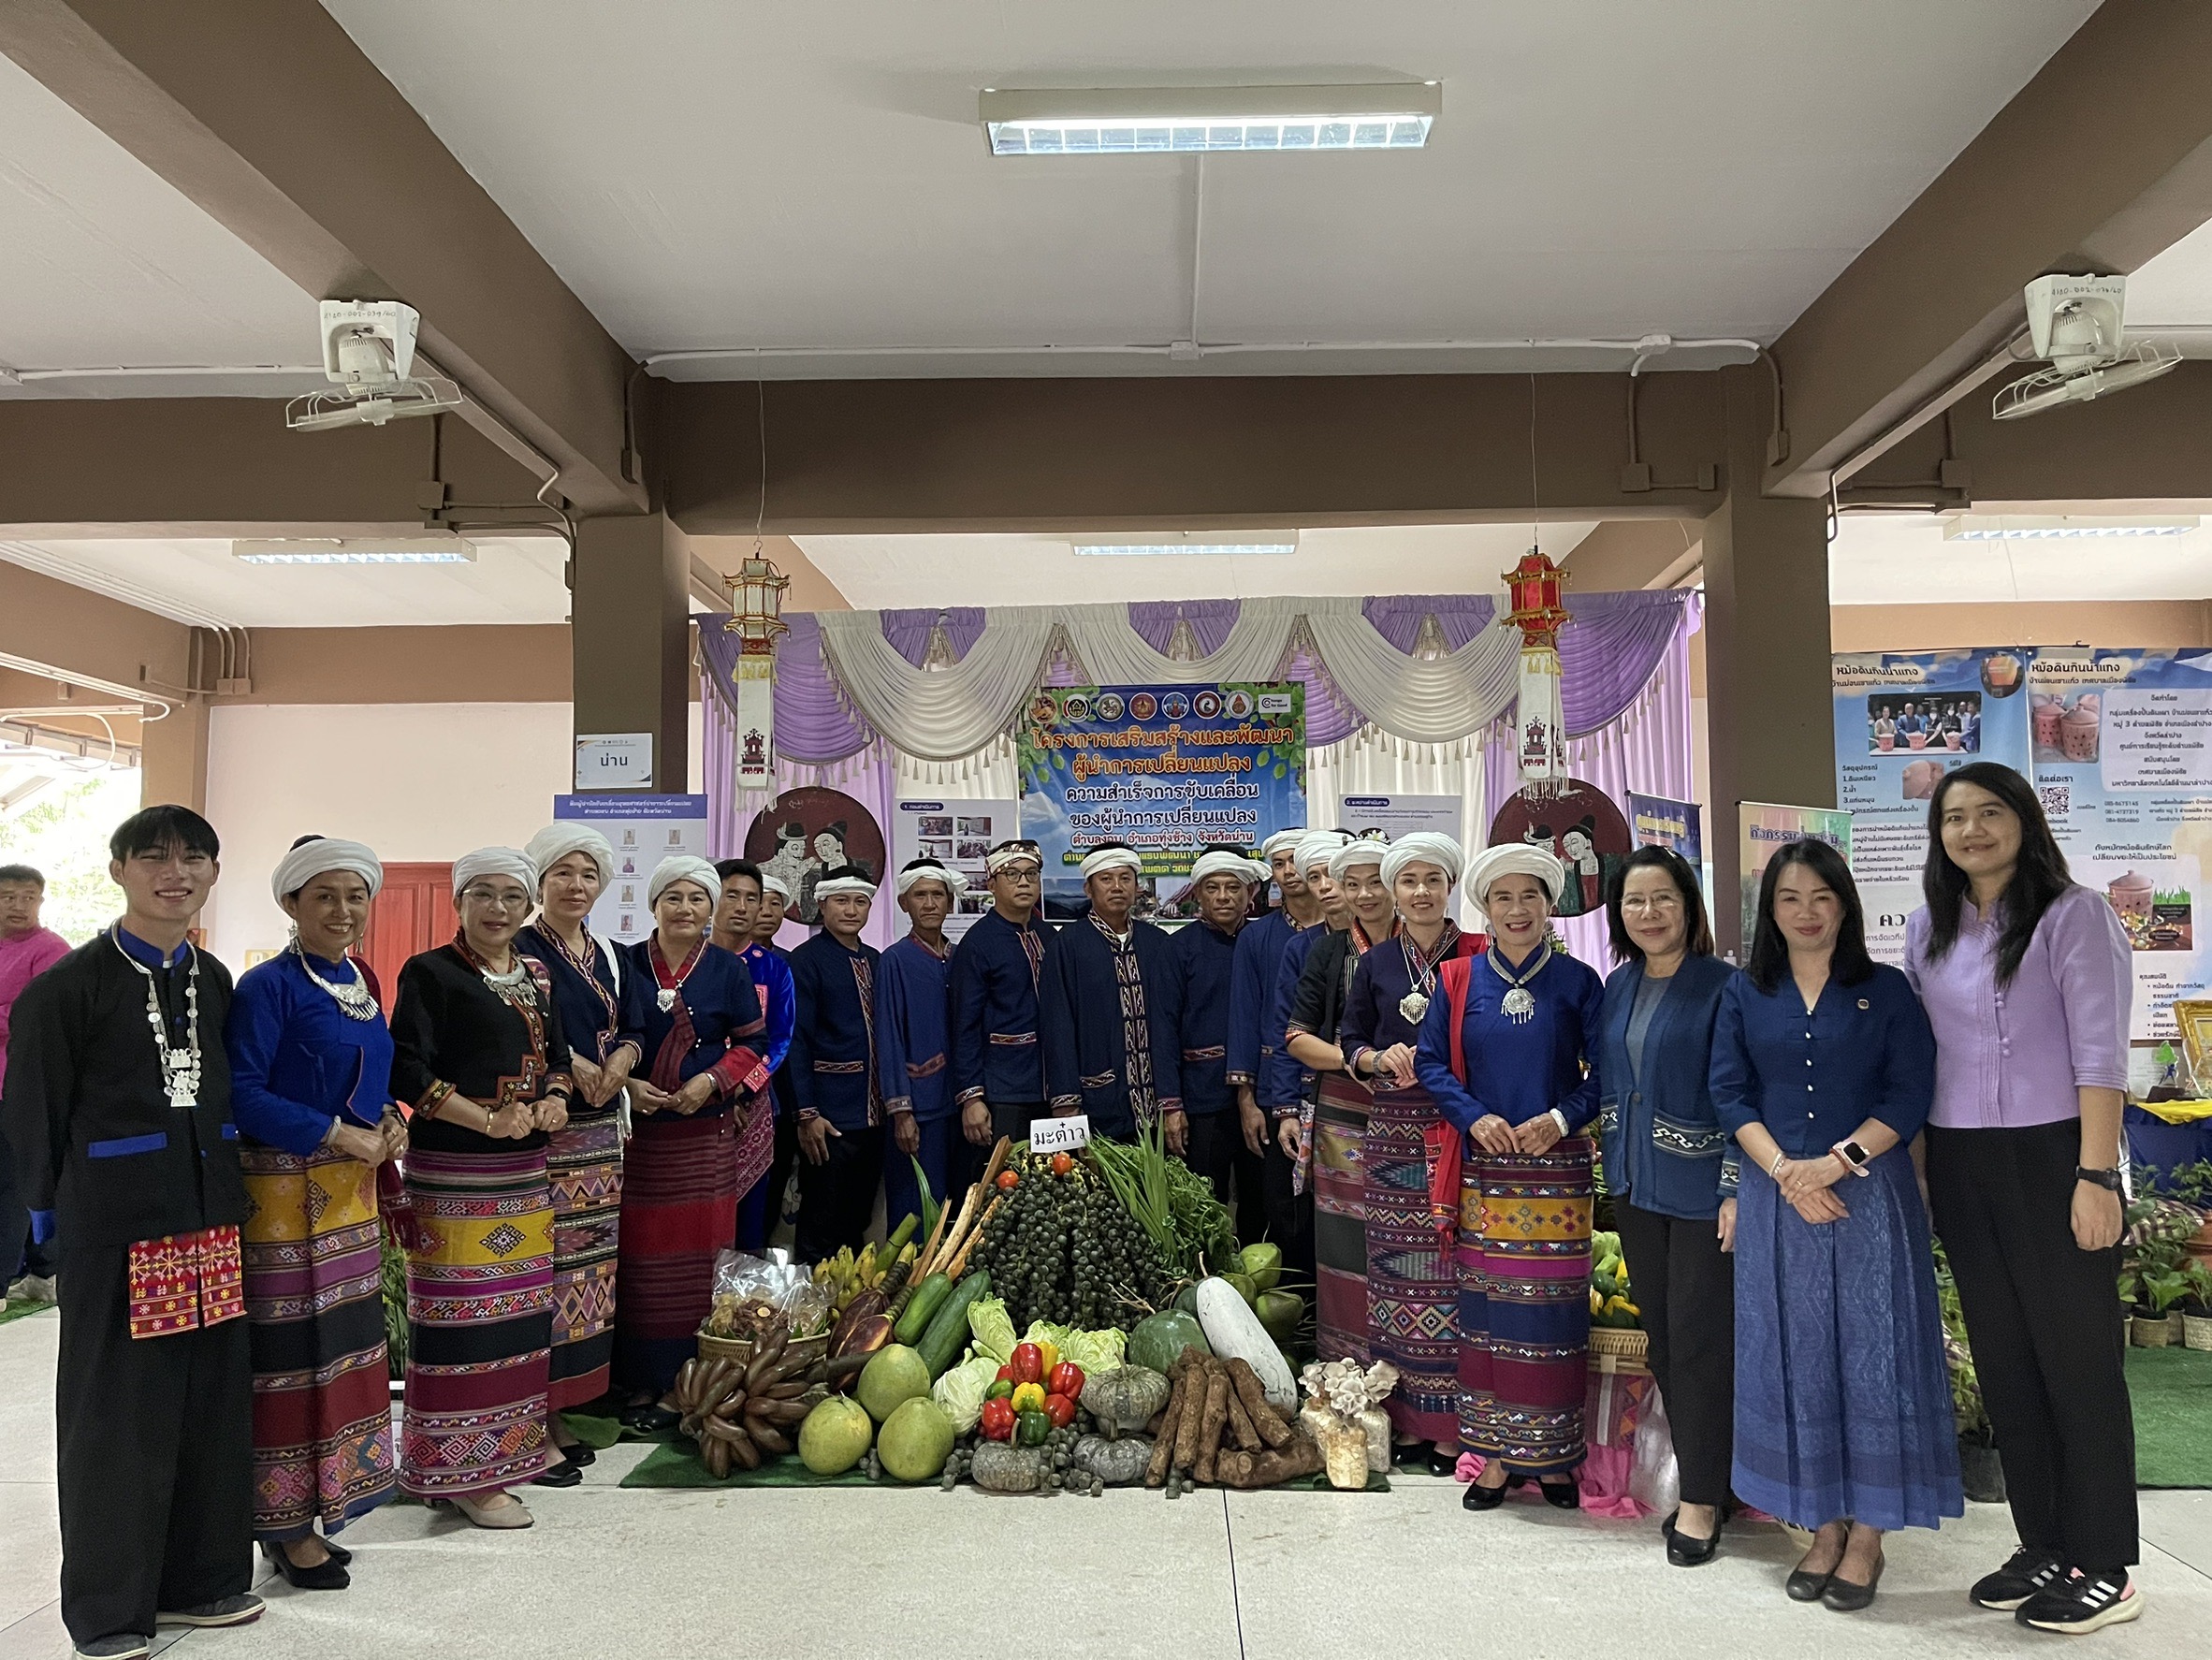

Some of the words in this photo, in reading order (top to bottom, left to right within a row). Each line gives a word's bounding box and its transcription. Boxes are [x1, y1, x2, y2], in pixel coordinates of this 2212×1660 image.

[1030, 722, 1294, 749] โครงการเสริมสร้างและพัฒนา
[600, 752, 628, 766] น่าน
[1072, 747, 1252, 781] ผู้นำการเปลี่ยนแปลง
[1066, 773, 1259, 802] ความสำเร็จการขับเคลื่อน
[1070, 800, 1258, 833] ของผู้นำการเปลี่ยนแปลง
[1127, 829, 1192, 849] อำเภอทุ่งช้าง
[1196, 829, 1255, 845] จังหวัดน่าน
[1880, 913, 1906, 926] คว
[1034, 1122, 1085, 1145] มะต๋าว
